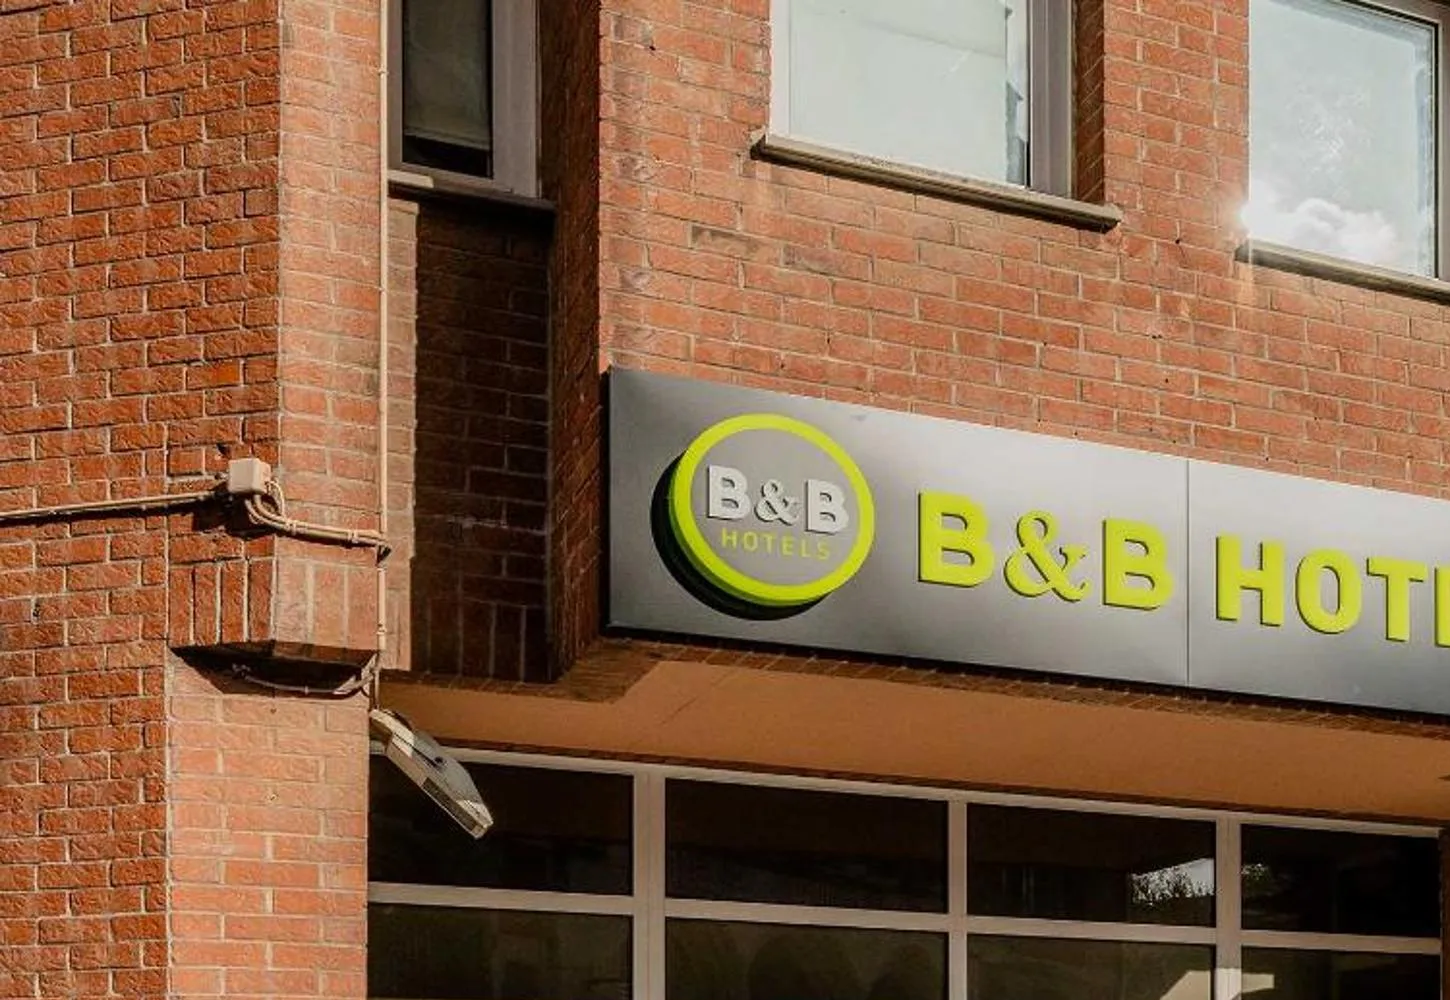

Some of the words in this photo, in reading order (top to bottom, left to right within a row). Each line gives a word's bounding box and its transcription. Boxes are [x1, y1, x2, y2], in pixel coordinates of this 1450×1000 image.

[706, 464, 850, 536] B&B
[721, 527, 831, 561] HOTELS
[918, 490, 1172, 612] B&B
